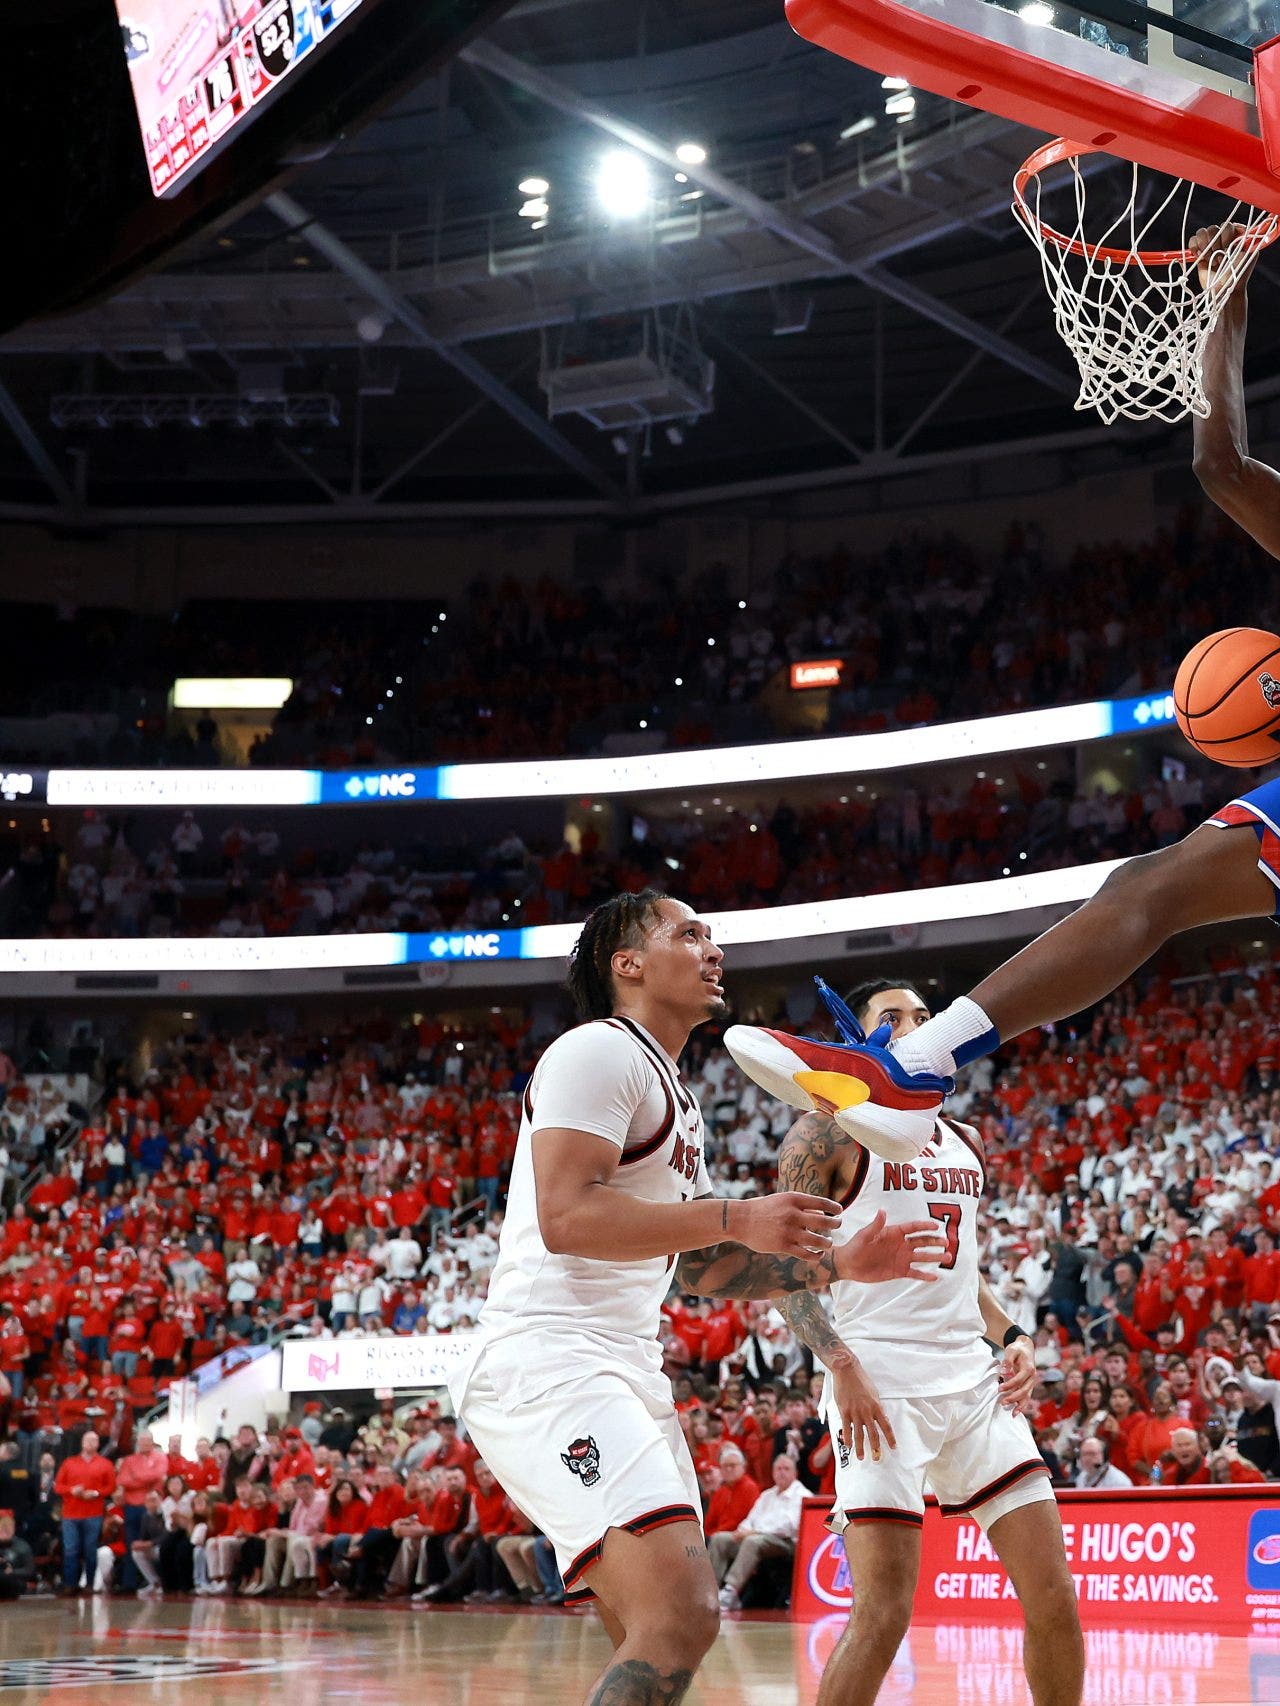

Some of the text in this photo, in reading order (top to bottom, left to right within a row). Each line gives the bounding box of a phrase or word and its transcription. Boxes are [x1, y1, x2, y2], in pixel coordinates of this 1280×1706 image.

[207, 59, 234, 111] 76
[379, 772, 416, 797] NC
[464, 933, 500, 957] NC
[883, 1162, 980, 1199] NC STATE
[926, 1202, 962, 1270] 7
[1080, 1521, 1196, 1562] HUGO'S
[934, 1572, 969, 1599] GET
[969, 1572, 999, 1599] THE
[1087, 1573, 1121, 1602] THE
[1122, 1573, 1219, 1603] SAVINGS.
